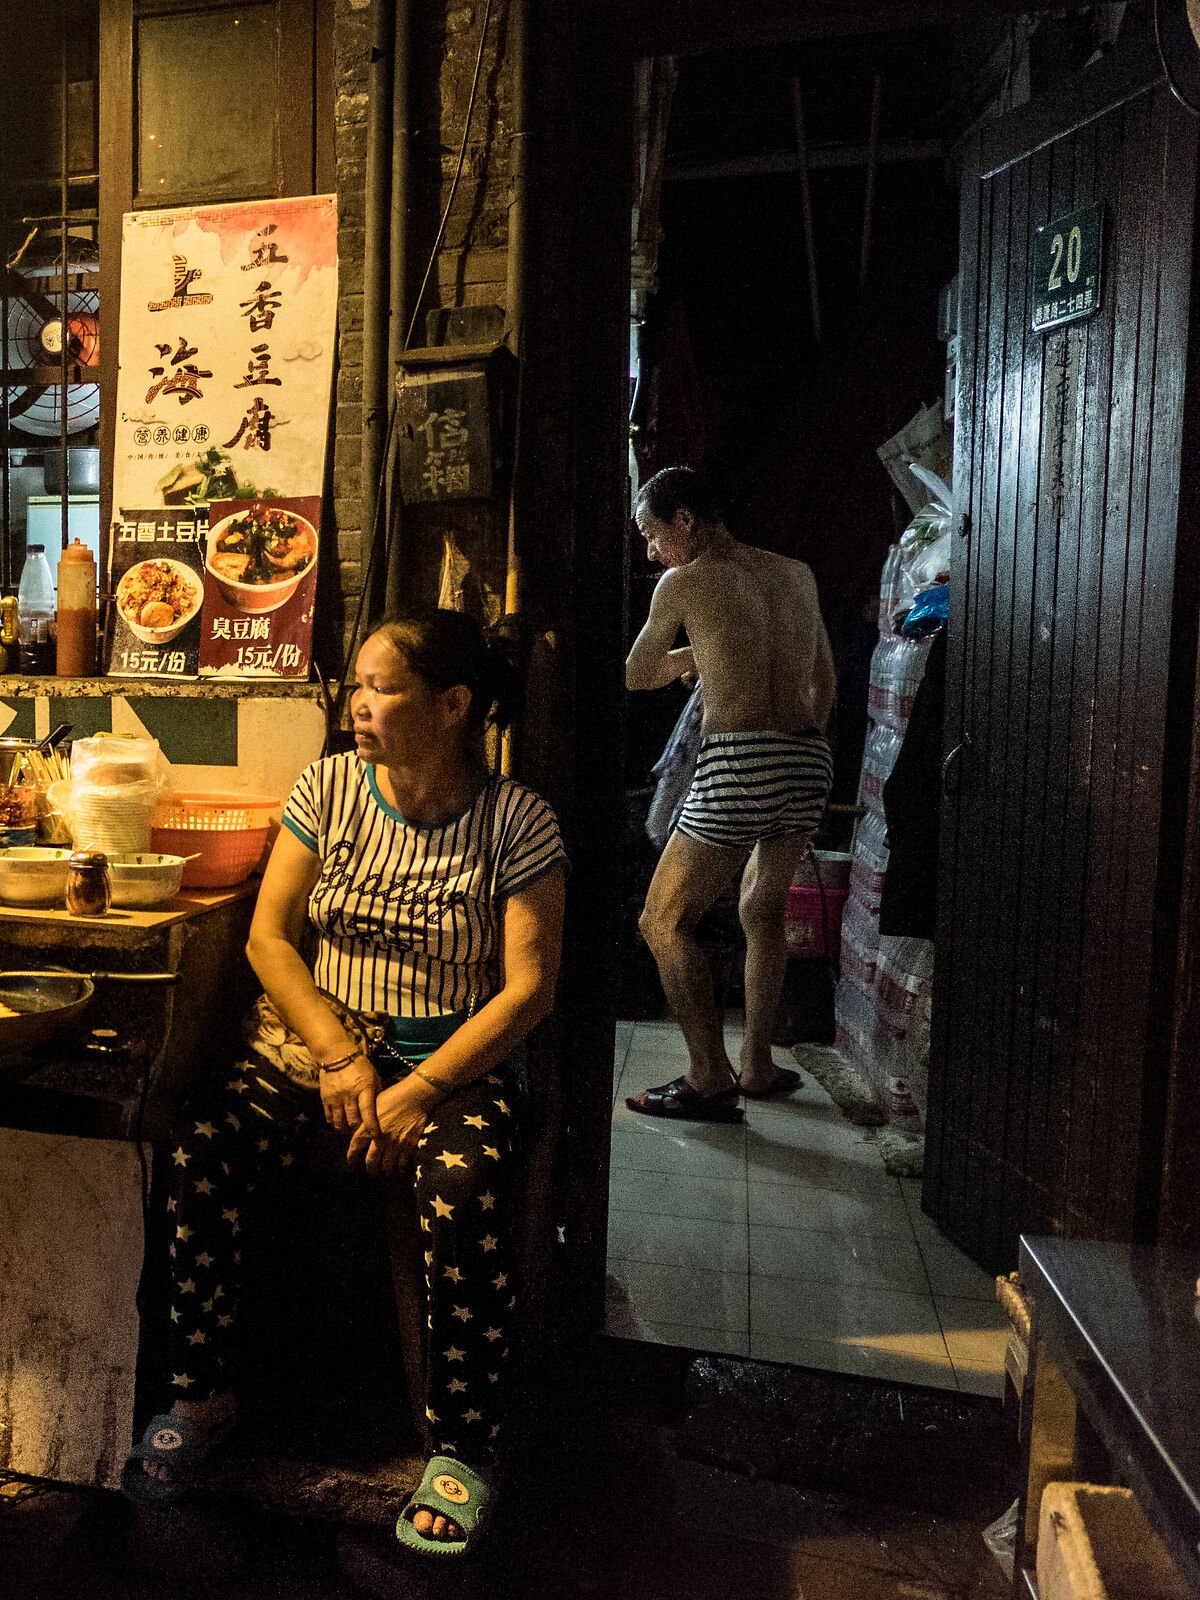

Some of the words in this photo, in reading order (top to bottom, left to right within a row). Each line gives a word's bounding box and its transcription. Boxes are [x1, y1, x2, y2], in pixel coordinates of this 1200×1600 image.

[1048, 226, 1081, 290] 20
[145, 254, 214, 405] 上海
[222, 223, 289, 451] 五香豆腐
[134, 424, 210, 446] 营养健康
[418, 408, 469, 494] 信箱
[118, 521, 209, 543] 五香土豆片
[210, 617, 271, 641] 臭豆腐
[121, 651, 186, 672] 15元/份
[237, 644, 301, 668] 15元/份
